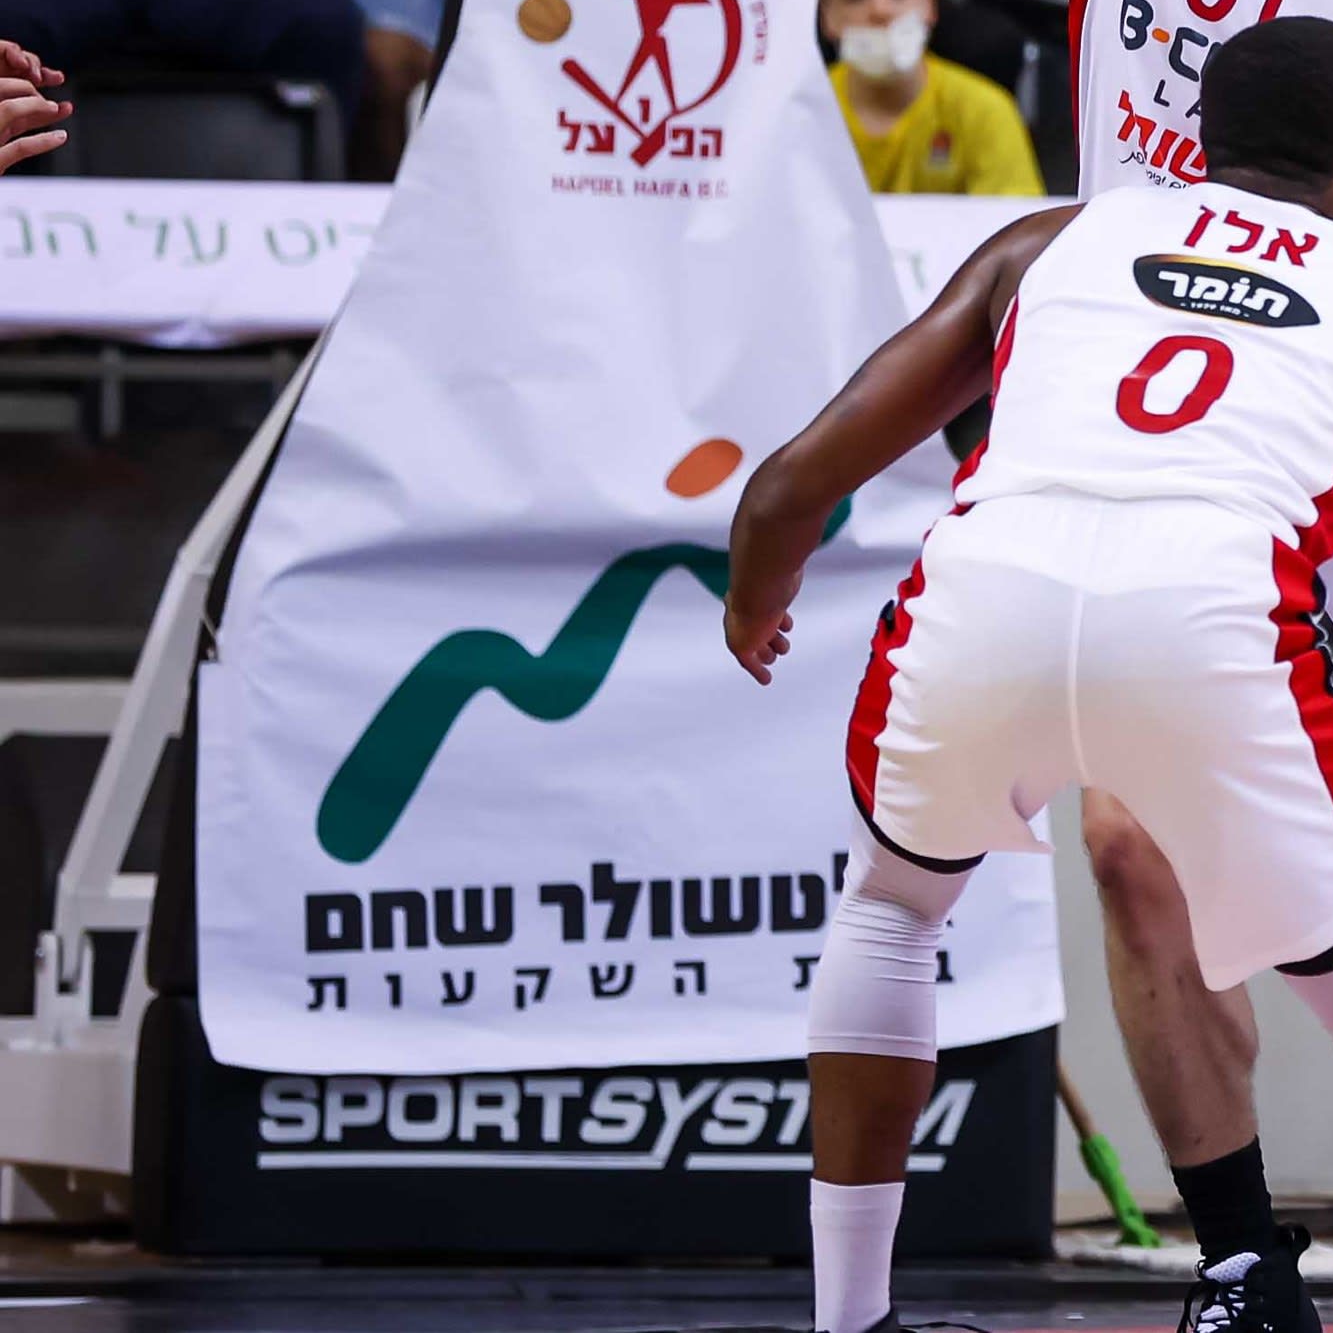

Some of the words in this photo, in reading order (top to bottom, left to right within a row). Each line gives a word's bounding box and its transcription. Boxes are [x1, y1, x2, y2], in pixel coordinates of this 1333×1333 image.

[125, 208, 229, 266] על
[264, 218, 378, 268] יט
[1183, 204, 1320, 268] אלן
[1116, 335, 1234, 434] 0
[305, 884, 514, 953] שחם
[539, 852, 851, 946] טשולר
[306, 960, 708, 1012] השקעות
[258, 1076, 977, 1148] SPORTSYSTM
